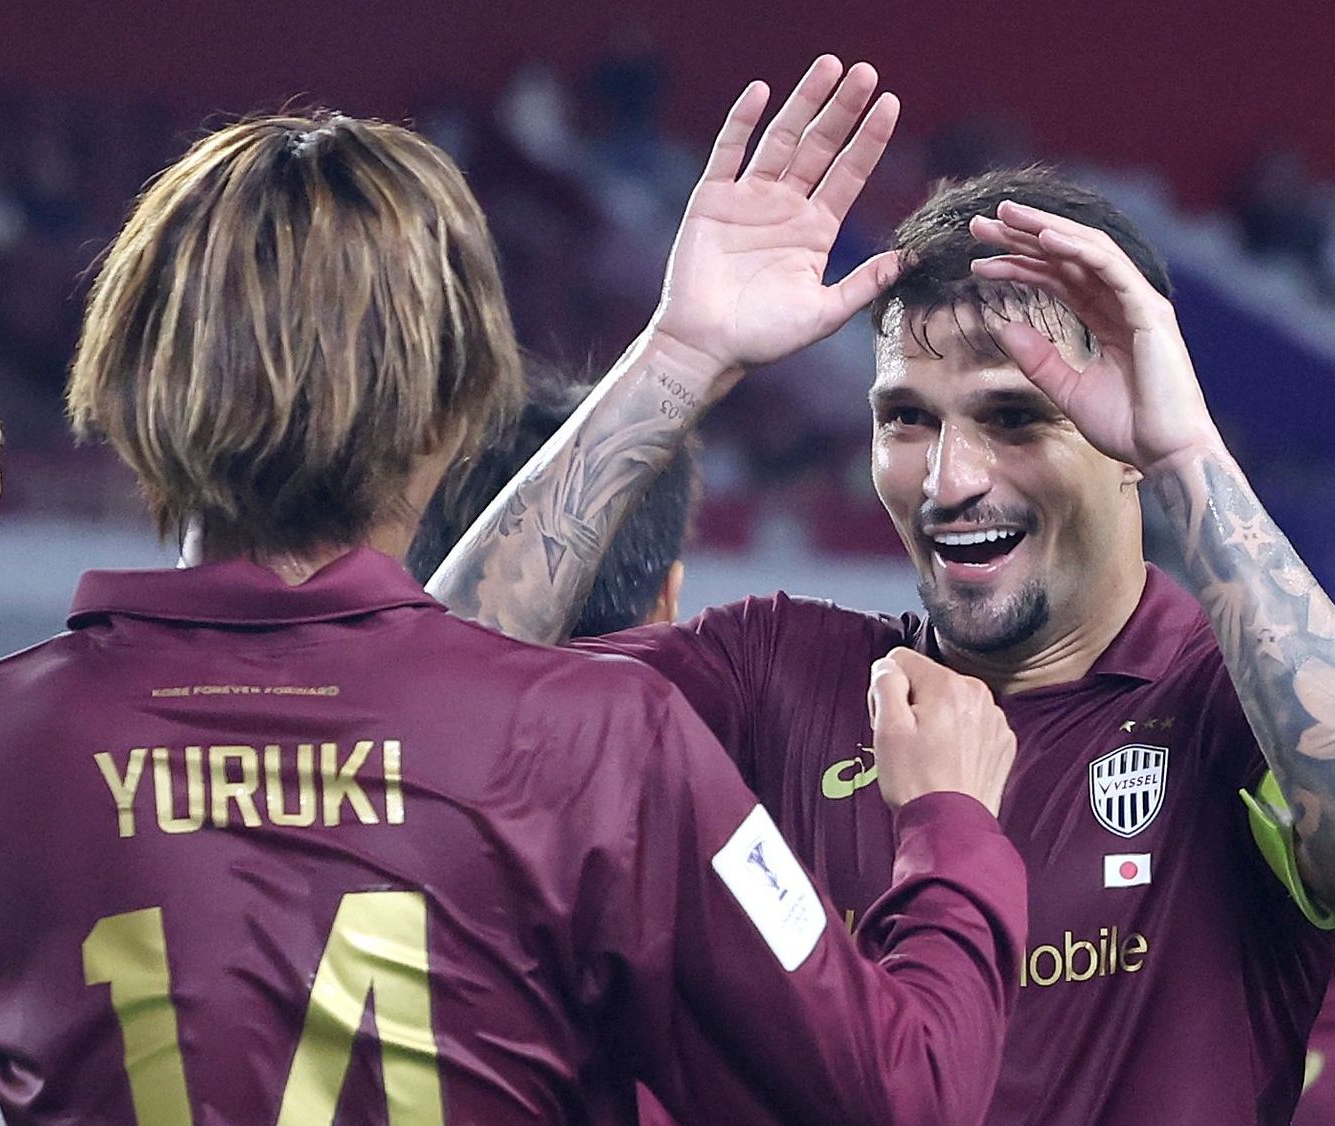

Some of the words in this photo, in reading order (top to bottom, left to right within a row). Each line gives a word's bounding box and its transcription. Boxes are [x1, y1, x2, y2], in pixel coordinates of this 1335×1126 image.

[93, 740, 405, 838] YURUKI
[1114, 773, 1158, 790] VISSEL
[1019, 925, 1148, 987] obile
